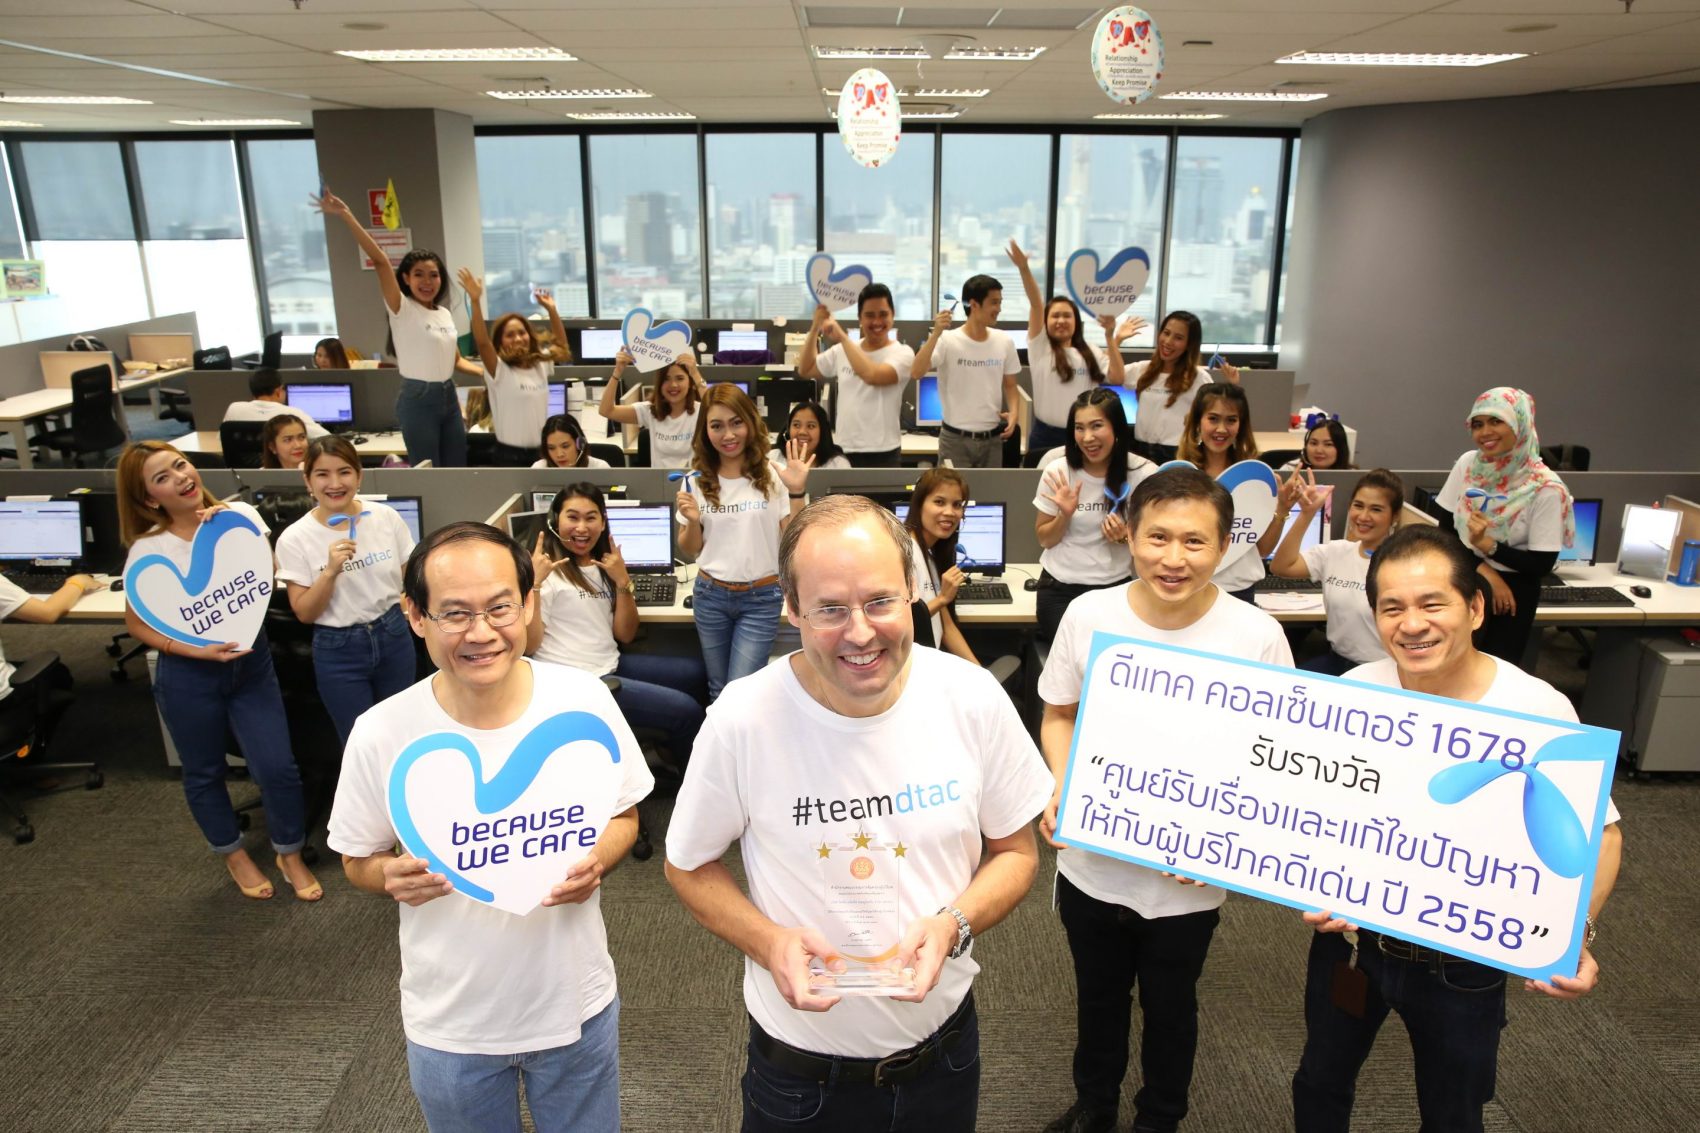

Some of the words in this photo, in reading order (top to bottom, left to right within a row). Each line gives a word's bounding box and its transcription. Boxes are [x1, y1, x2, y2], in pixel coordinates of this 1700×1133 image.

[1105, 54, 1138, 63] Relationship
[1112, 79, 1125, 87] Keep
[700, 500, 769, 515] #teamdtac
[191, 609, 224, 635] we
[1110, 653, 1195, 701] ดีแทค
[1205, 681, 1419, 747] คอลเซ็นเตอร์
[1431, 722, 1527, 771] 1678
[1249, 734, 1381, 794] รับรางวัล
[792, 779, 961, 826] #teamdtac
[457, 844, 510, 871] we
[1081, 795, 1371, 906] ให้กับผู้บริโภคดีเด่น
[1382, 879, 1409, 915] ปี
